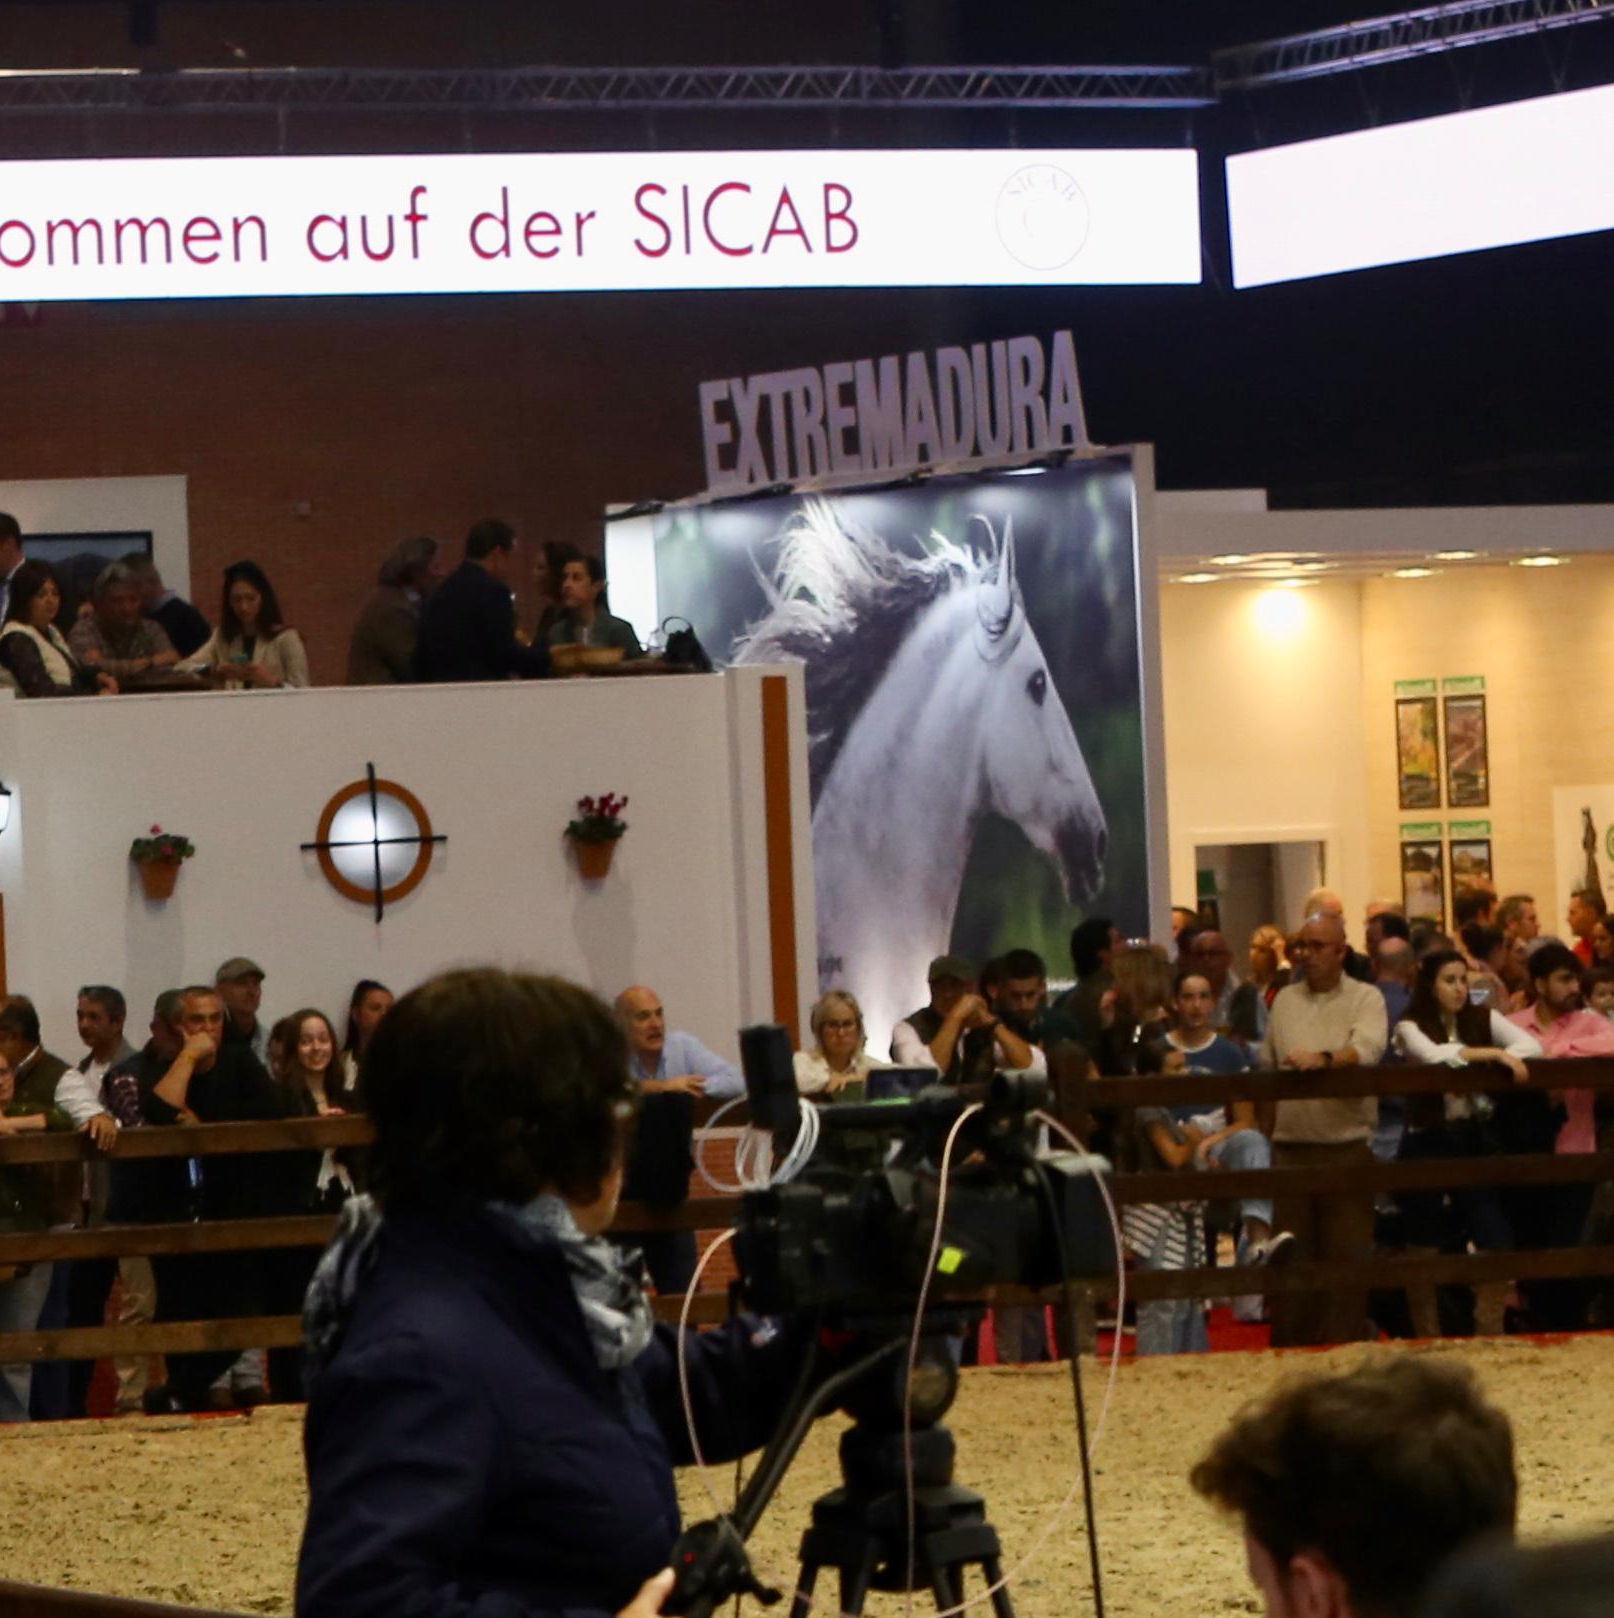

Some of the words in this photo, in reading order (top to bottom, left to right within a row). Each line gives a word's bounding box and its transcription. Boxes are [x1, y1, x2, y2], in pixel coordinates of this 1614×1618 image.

[306, 186, 428, 264] auf
[468, 186, 596, 261] der
[633, 181, 859, 259] SICAB
[698, 329, 1090, 484] EXTREMADURA
